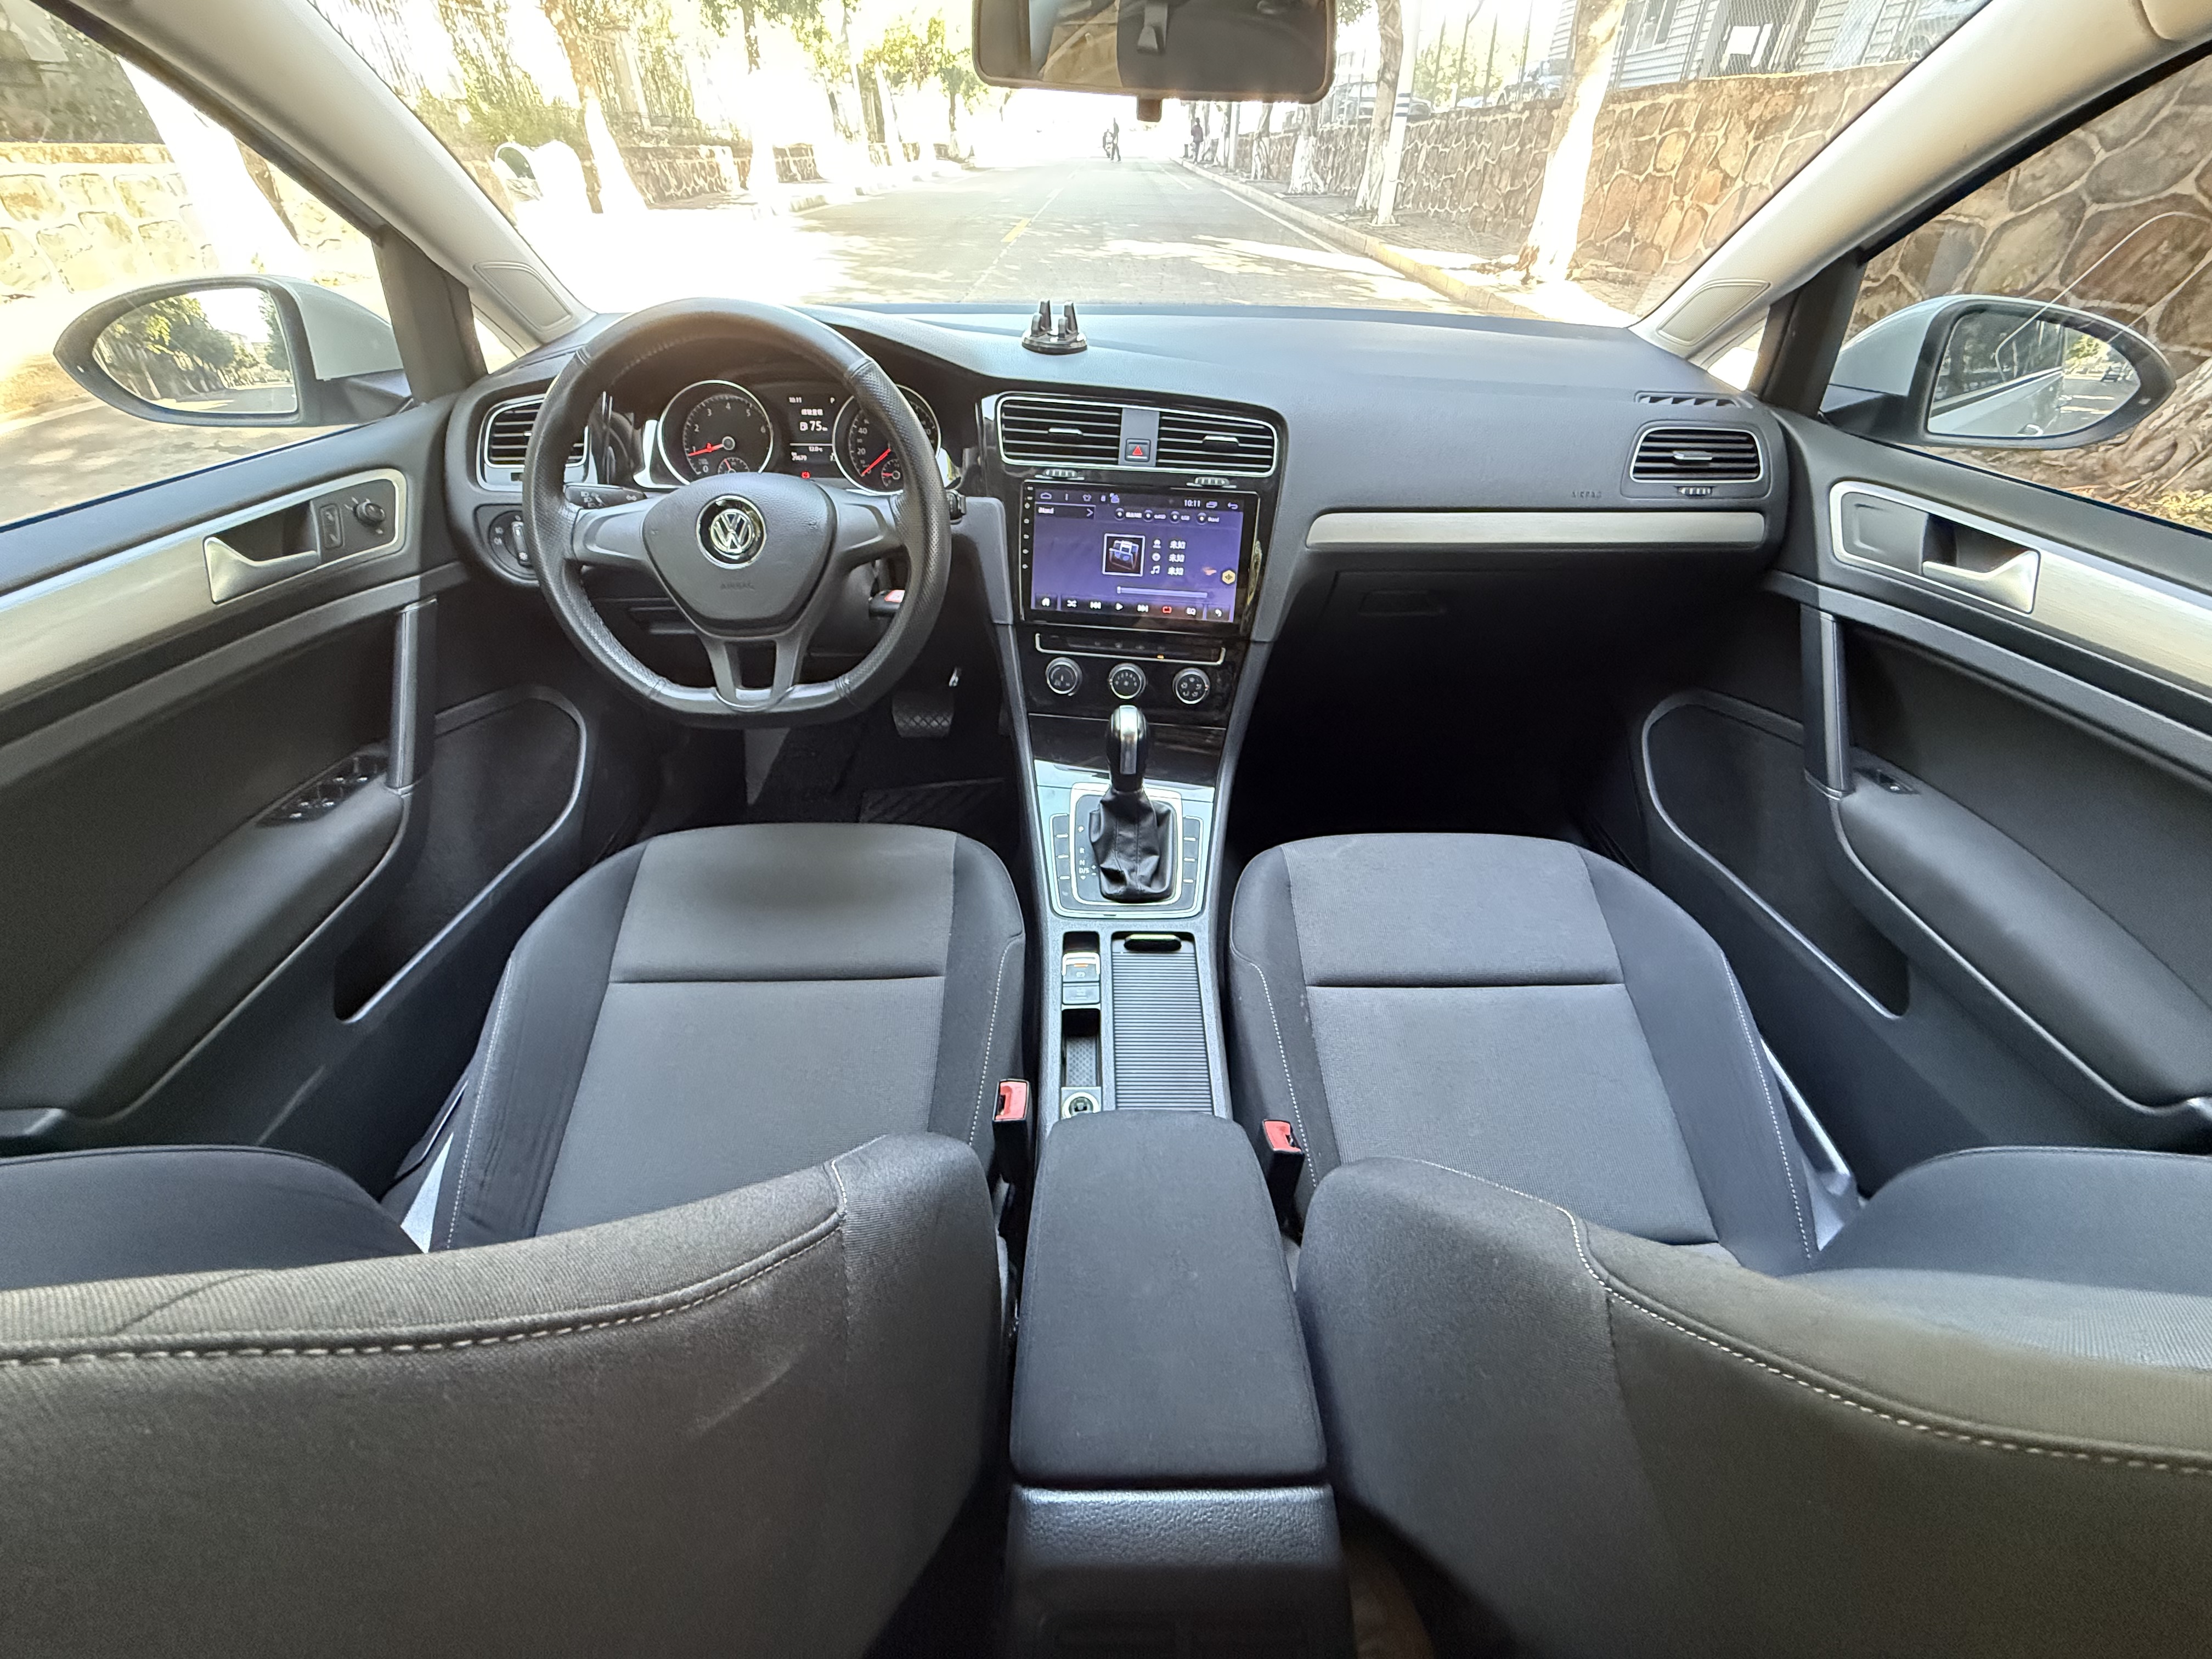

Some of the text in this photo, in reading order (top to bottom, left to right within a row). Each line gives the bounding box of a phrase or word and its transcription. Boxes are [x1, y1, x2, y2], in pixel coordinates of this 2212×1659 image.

[707, 408, 712, 416] 3
[746, 409, 751, 417] 5
[694, 424, 699, 432] 2
[809, 420, 822, 431] 75
[703, 465, 709, 473] 0
[1184, 499, 1201, 507] 10:11
[1169, 540, 1186, 549] 未知
[1169, 553, 1185, 563] 未知
[1167, 566, 1184, 575] 未知
